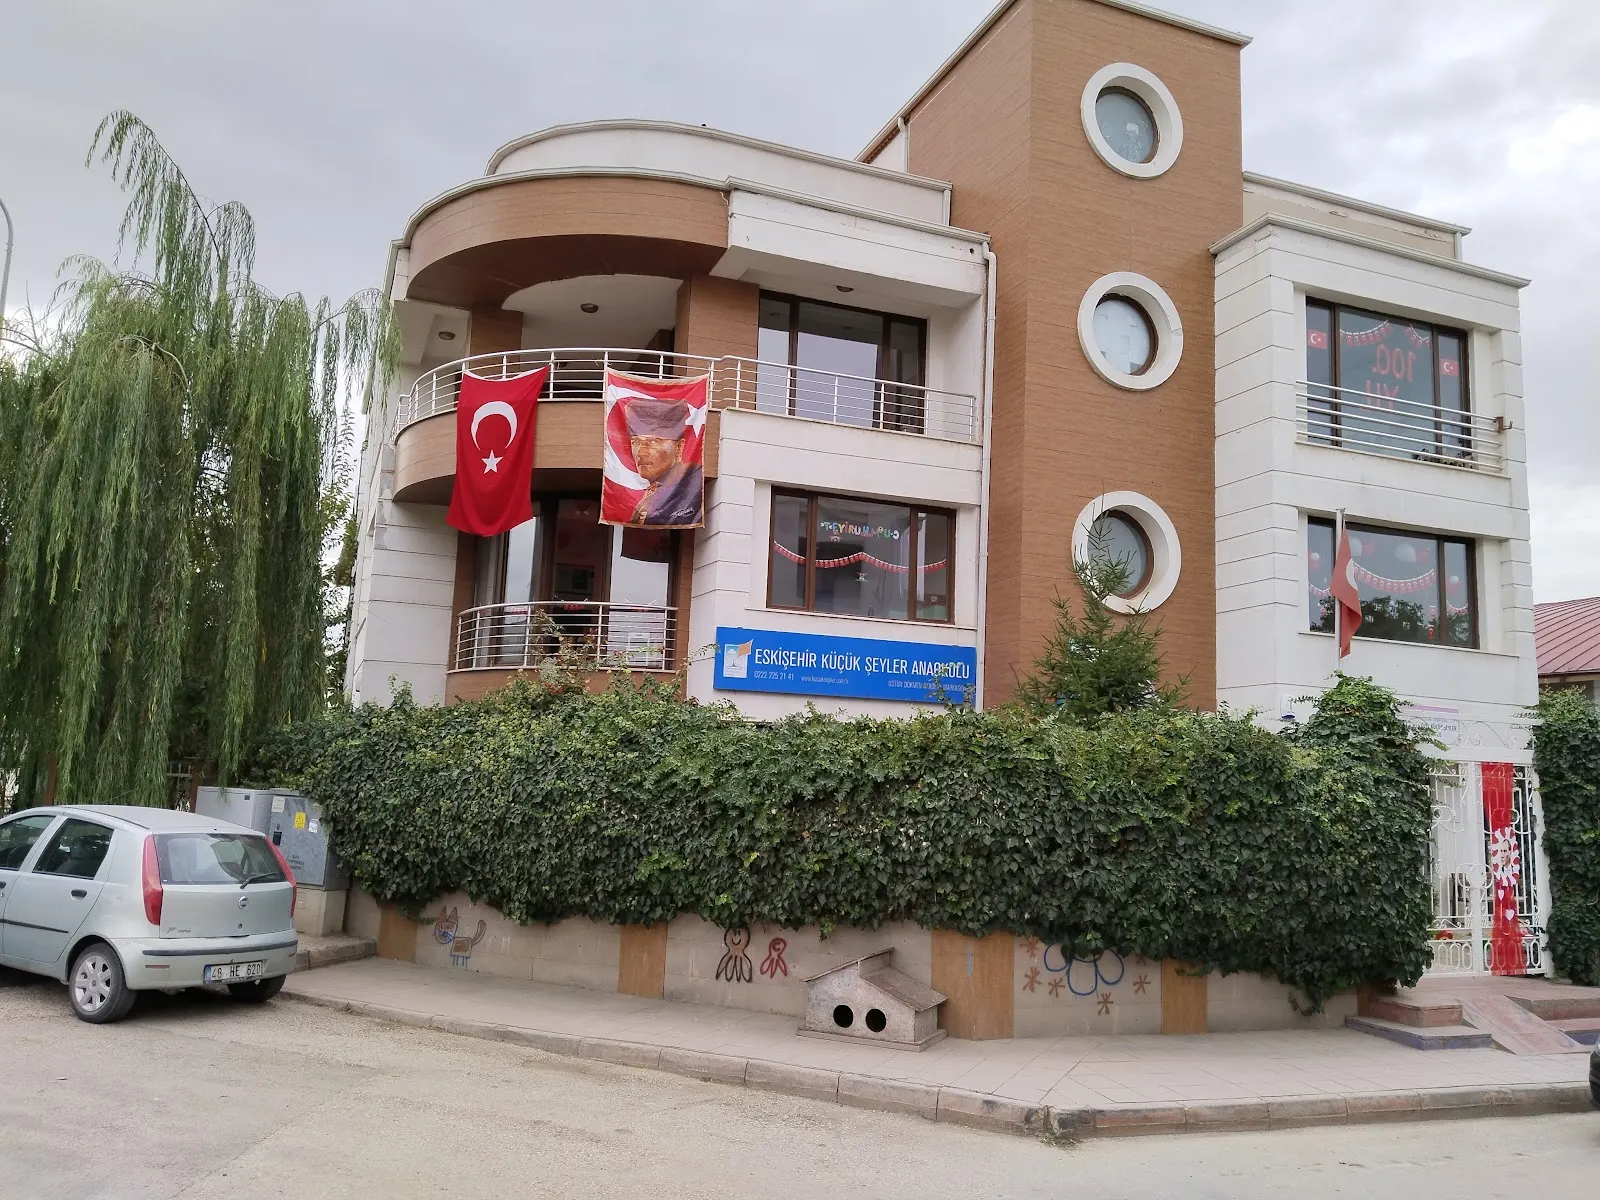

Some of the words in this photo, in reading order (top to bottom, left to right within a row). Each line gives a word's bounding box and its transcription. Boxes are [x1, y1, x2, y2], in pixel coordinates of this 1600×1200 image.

[755, 647, 817, 670] ESKİŞEHİR
[821, 651, 860, 674] KÜÇÜK
[865, 656, 908, 676] ŞEYLER
[754, 670, 767, 679] 0222
[768, 671, 778, 680] 225
[779, 672, 786, 680] 21
[788, 673, 794, 681] 41
[230, 965, 240, 977] HE
[247, 963, 261, 976] 620
